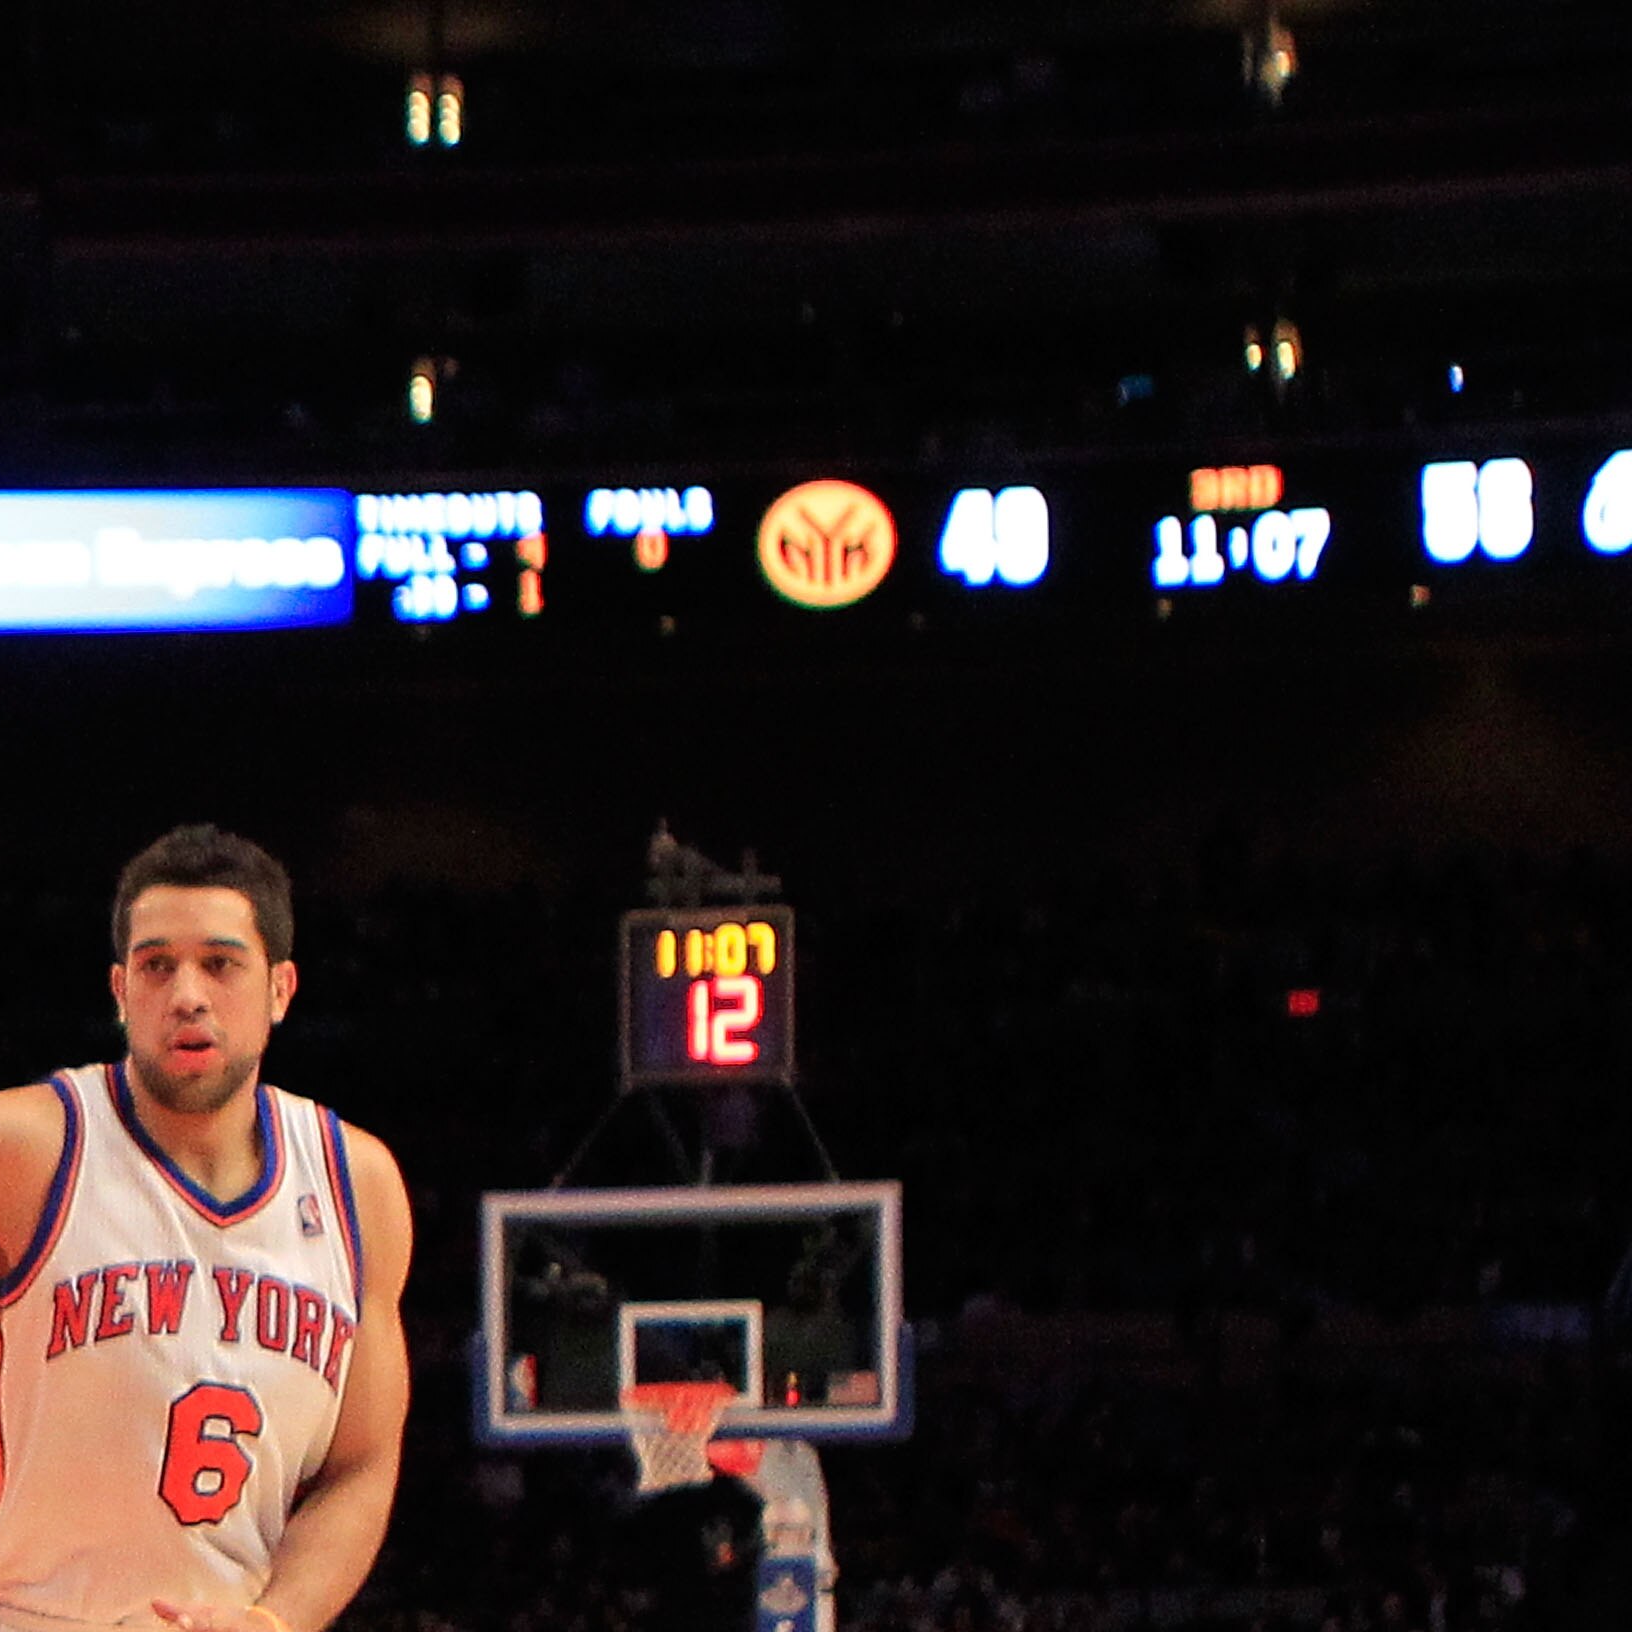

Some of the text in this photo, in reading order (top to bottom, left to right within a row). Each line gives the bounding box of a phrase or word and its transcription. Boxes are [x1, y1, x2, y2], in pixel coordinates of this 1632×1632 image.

[1152, 508, 1331, 586] 11:07
[656, 921, 776, 978] 11:07
[687, 976, 765, 1065] 12
[47, 1259, 195, 1362] NEW
[157, 1379, 264, 1526] 6
